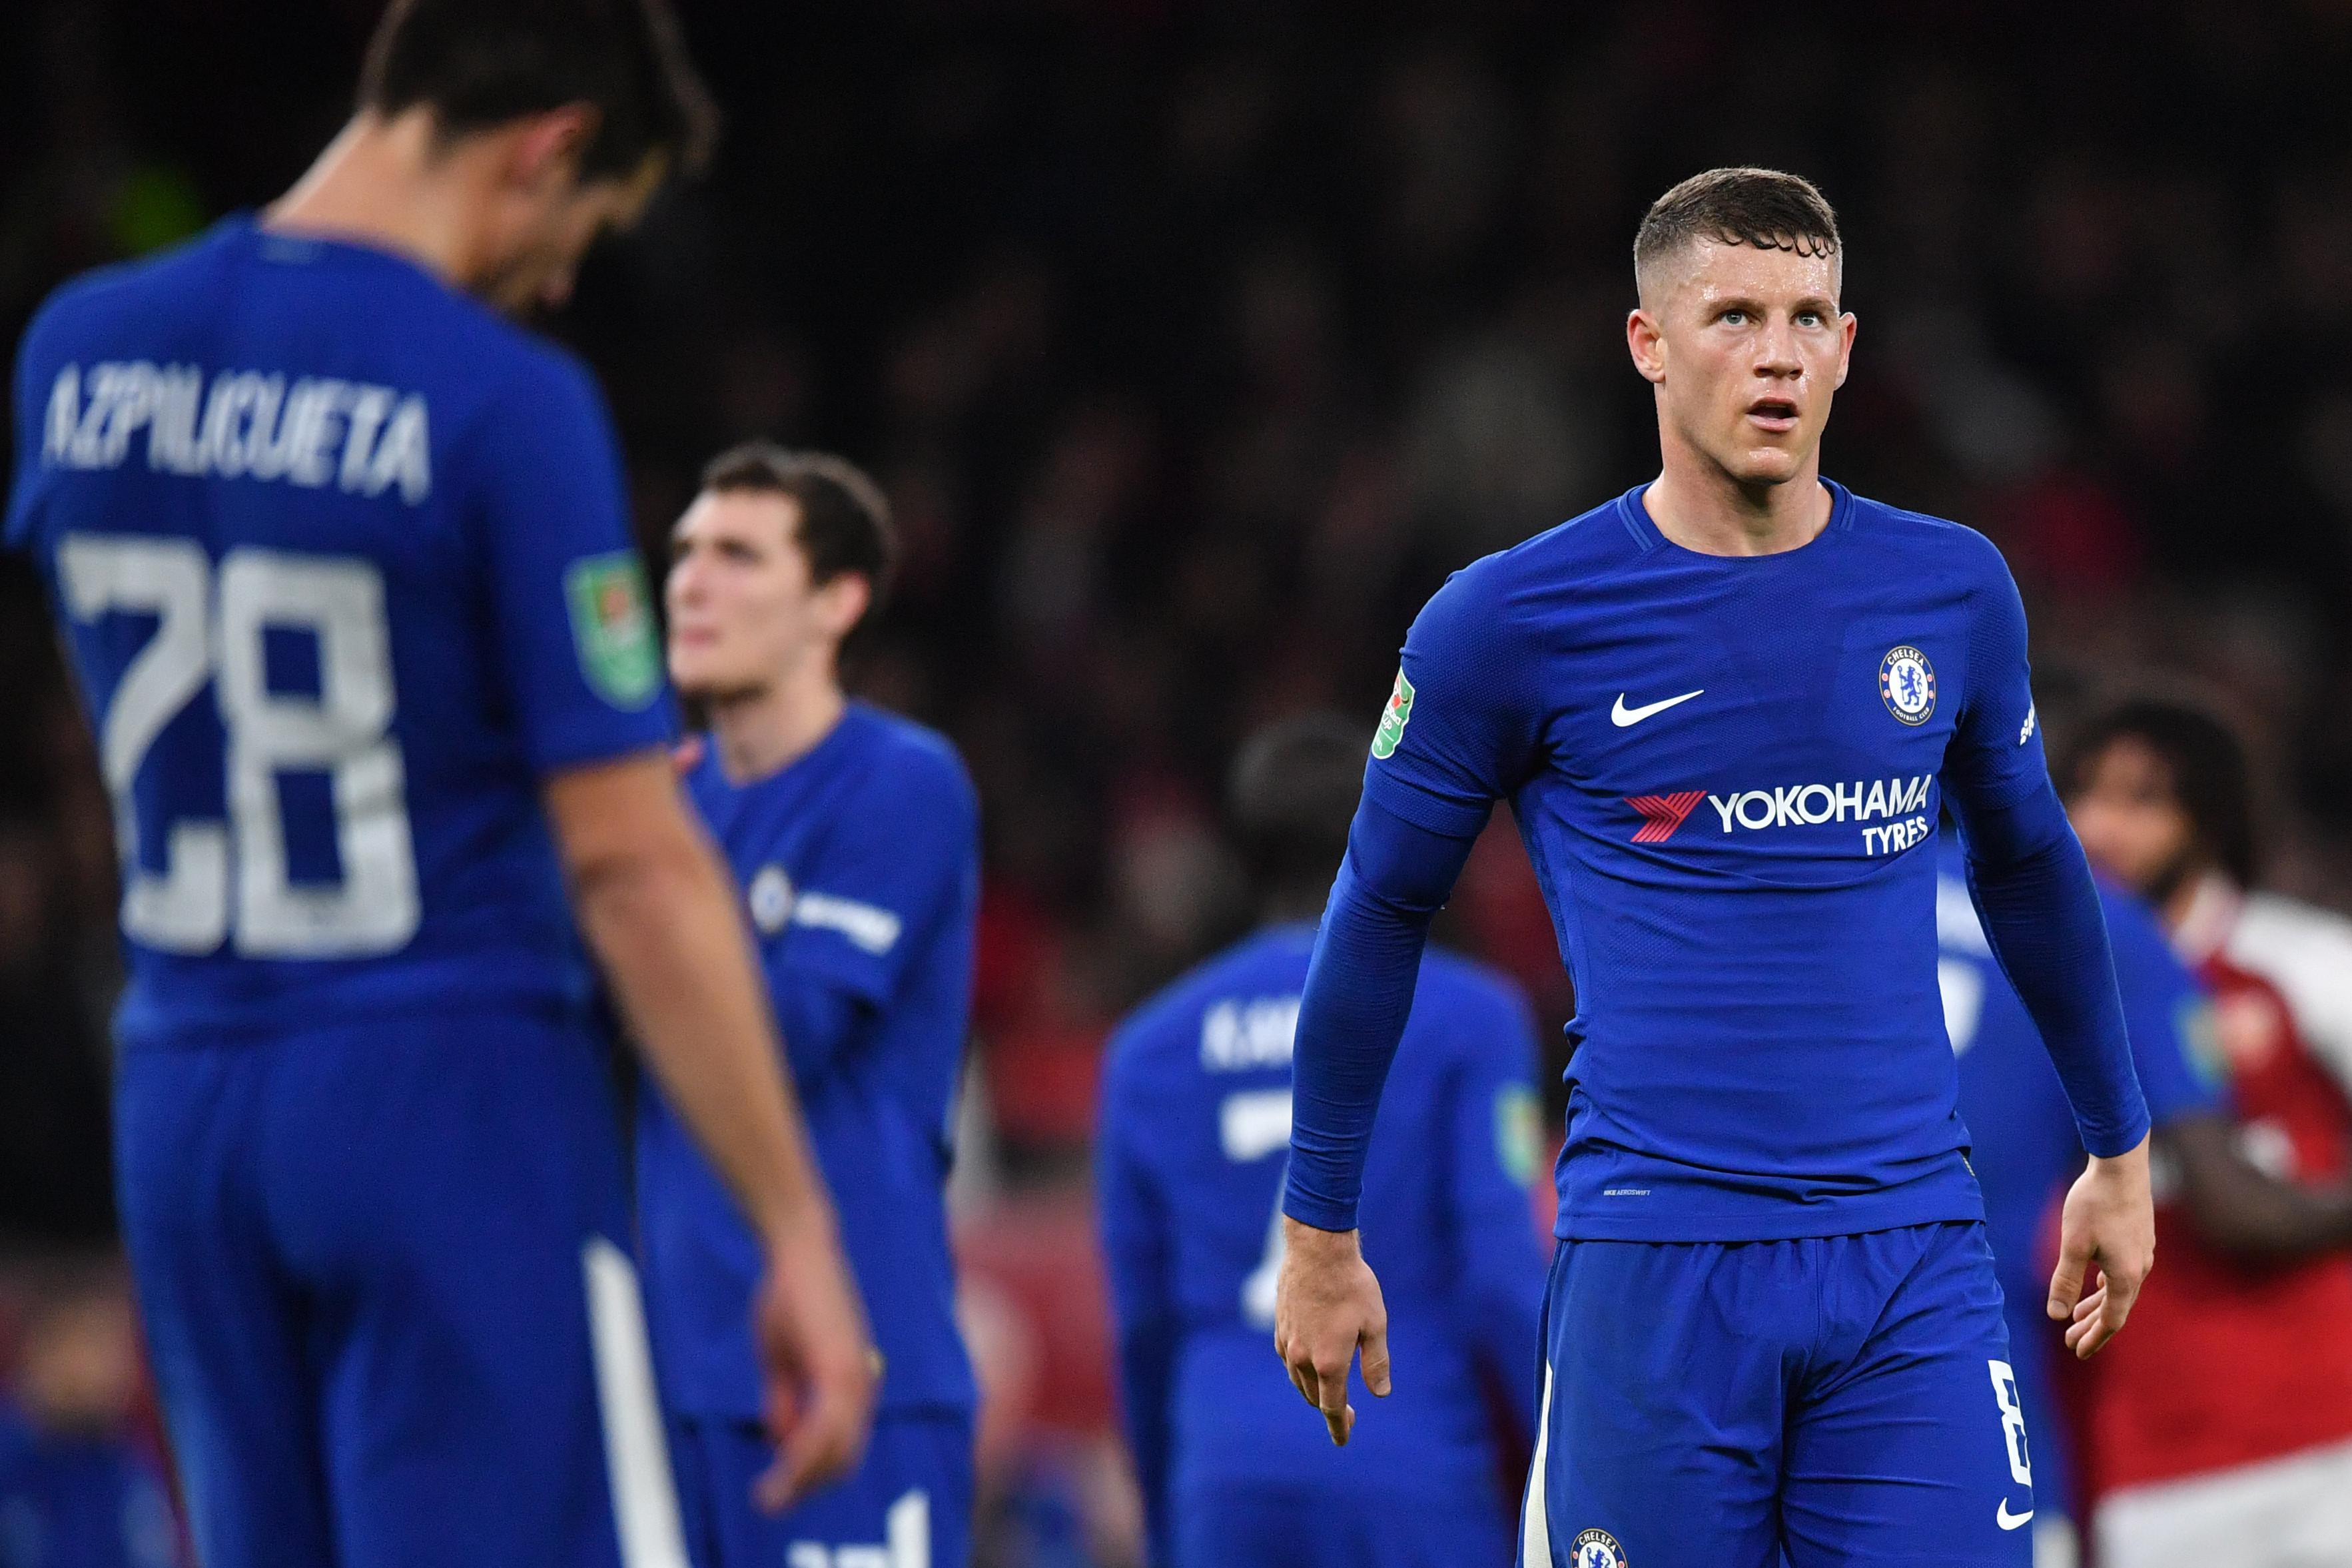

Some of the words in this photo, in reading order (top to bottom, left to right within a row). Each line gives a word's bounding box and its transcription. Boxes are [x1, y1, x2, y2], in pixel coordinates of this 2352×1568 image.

[44, 362, 430, 503] AZPILICUETA
[1887, 649, 1924, 666] CHELSEA
[1893, 707, 1918, 721] FOOTBALL
[59, 536, 420, 957] 28
[1708, 774, 1932, 833] YOKOHAMA
[1862, 815, 1928, 855] TYRES
[1988, 1360, 2032, 1489] 8
[1579, 1531, 1617, 1553] CHELSEA
